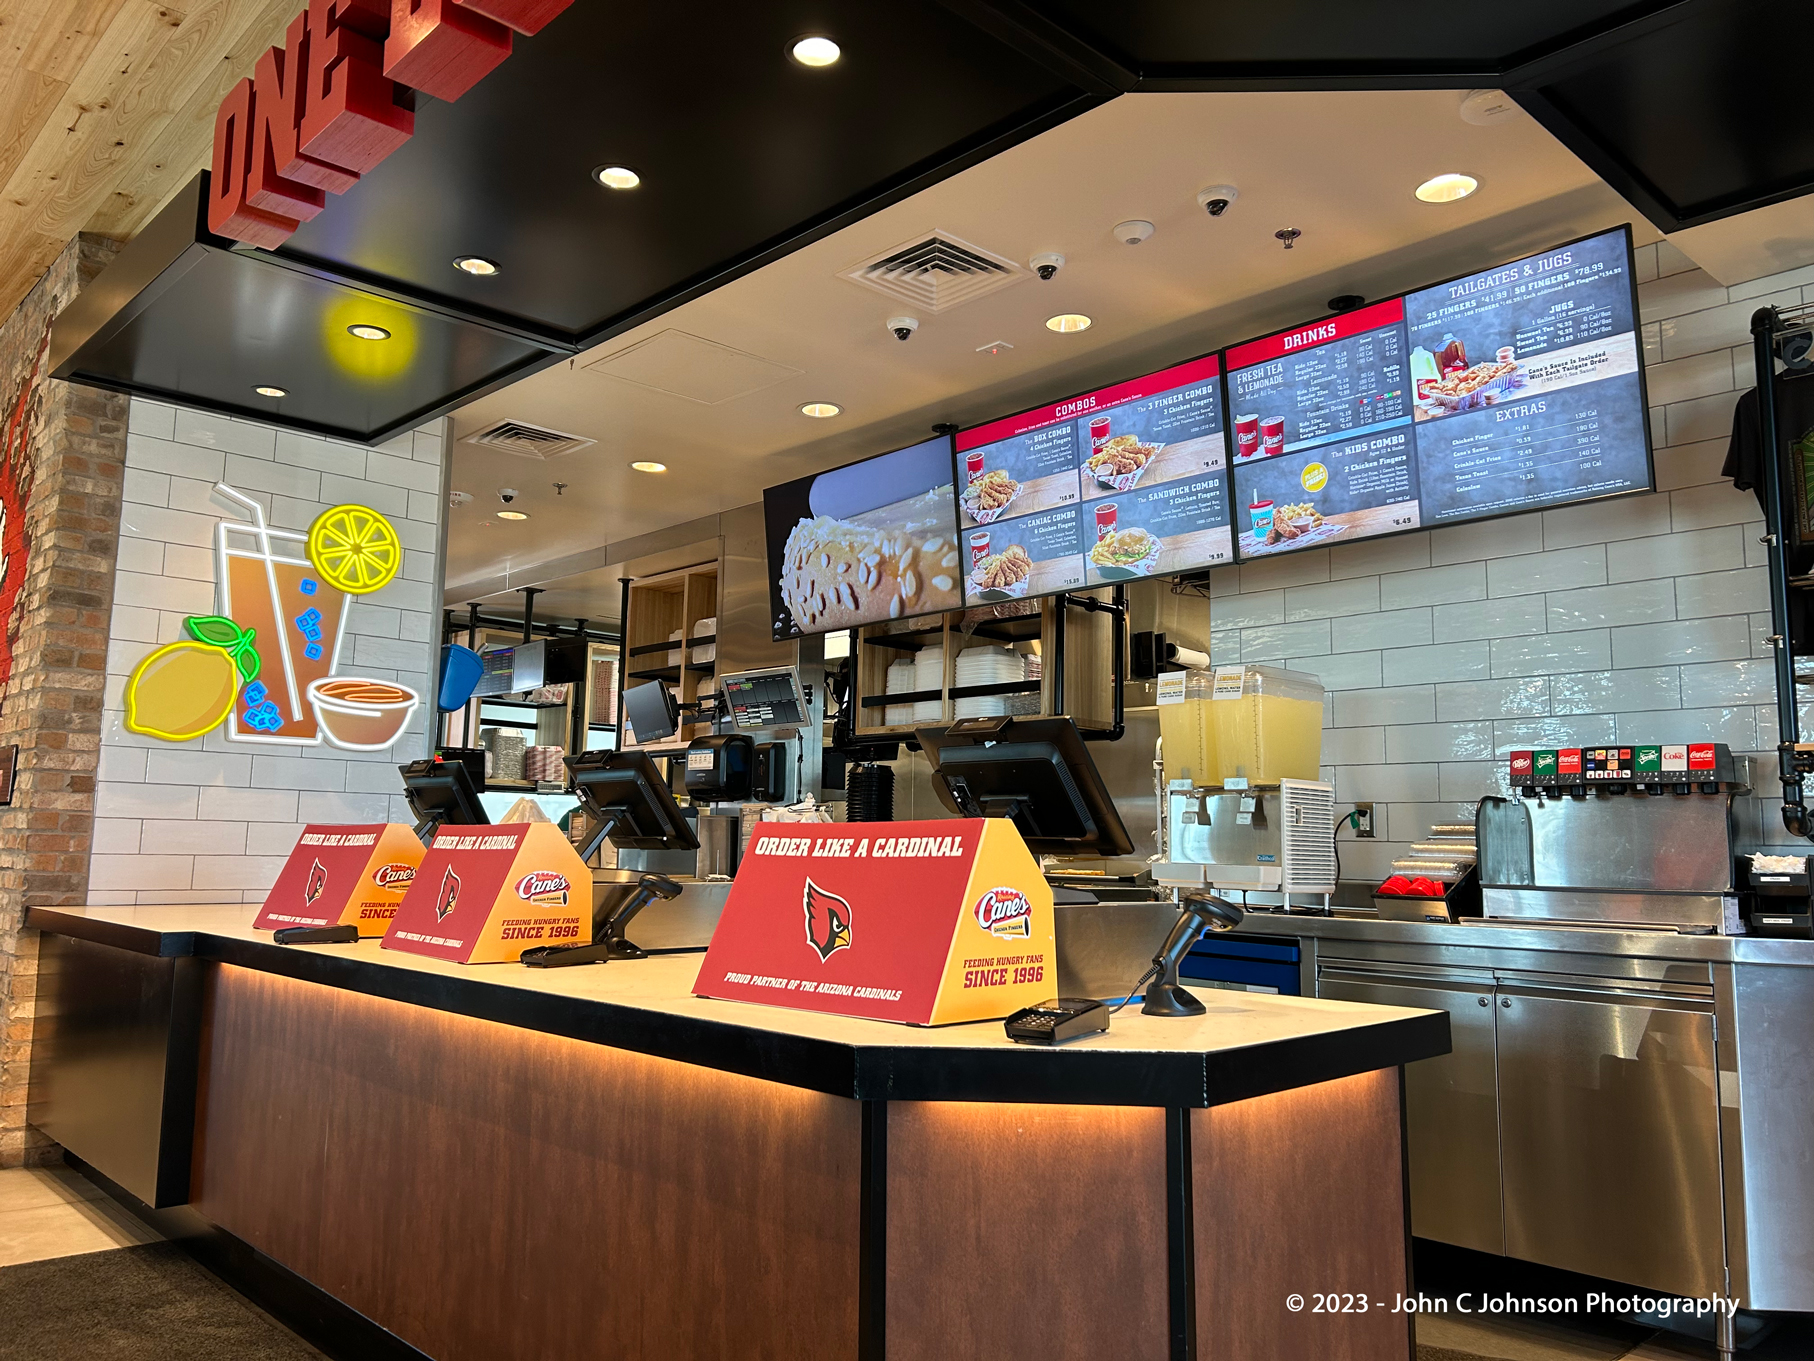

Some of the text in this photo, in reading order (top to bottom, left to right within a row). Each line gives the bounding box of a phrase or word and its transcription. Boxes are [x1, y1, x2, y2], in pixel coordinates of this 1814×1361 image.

[1448, 251, 1571, 298] TAILGATES & JUGS
[1426, 262, 1603, 319] 25 FINGERS $41.99 50 FINGERS $78.99
[1548, 300, 1573, 313] JUGS
[1536, 314, 1554, 323] Gallon
[1283, 322, 1336, 350] DRINKS
[1516, 337, 1534, 346] Sweet
[1517, 341, 1546, 353] Lemonade
[1528, 365, 1547, 374] Cane's
[1549, 360, 1567, 369] Sauce
[1578, 351, 1605, 362] Included
[1545, 368, 1560, 376] Each
[1562, 361, 1588, 372] Tailgate
[1590, 356, 1608, 365] Order
[1237, 362, 1283, 384] FRESH TEA
[1237, 373, 1283, 394] & LEMONADE
[1147, 402, 1152, 410] 3
[1154, 393, 1183, 408] FINGER
[1185, 384, 1212, 399] COMBO
[1168, 402, 1190, 413] Chicken
[1191, 396, 1213, 408] Fingers
[1055, 396, 1095, 417] COMBOS
[1495, 400, 1546, 422] EXTRAS
[1033, 432, 1046, 442] BOX
[1048, 425, 1070, 438] COMBO
[1452, 432, 1493, 445] Chicken Finger
[1034, 440, 1052, 450] Chicken
[1053, 435, 1071, 445] Fingers
[1344, 442, 1367, 455] KIDS
[1370, 434, 1404, 449] COMBO
[1350, 459, 1377, 471] Chicken
[1379, 453, 1406, 466] Fingers
[1148, 485, 1189, 501] SANDWICH
[1191, 478, 1218, 491] COMBO
[1174, 494, 1196, 504] Chicken
[1197, 489, 1219, 500] Fingers
[1027, 516, 1050, 527] CANIAC
[1052, 510, 1075, 521] COMBO
[1038, 524, 1056, 533] Chicken
[1057, 520, 1075, 529] Fingers
[1393, 516, 1411, 525] $6.49
[1559, 755, 1579, 763] Coca-Cola
[1664, 752, 1685, 760] Coke
[1690, 750, 1713, 759] Coca-Cola
[301, 833, 377, 846] ORDER LIKE A CARDINAL
[433, 835, 518, 850] ORDER LIKE A CARDINAL
[755, 836, 963, 858] ORDER LIKE A CARDINAL
[375, 865, 417, 886] Cane's
[518, 874, 569, 900] Cane's
[360, 908, 398, 919] SINCE
[978, 890, 1029, 929] Cane's
[501, 917, 580, 927] FEEDING HUNGRY FANS
[501, 925, 580, 940] SINCE 1996
[963, 954, 1044, 969] FEEDING HUNGRY FANS
[963, 965, 1044, 989] SINCE 1996
[724, 971, 903, 1002] PROUD PARTNER OF THE ARIZONA CARDINALS
